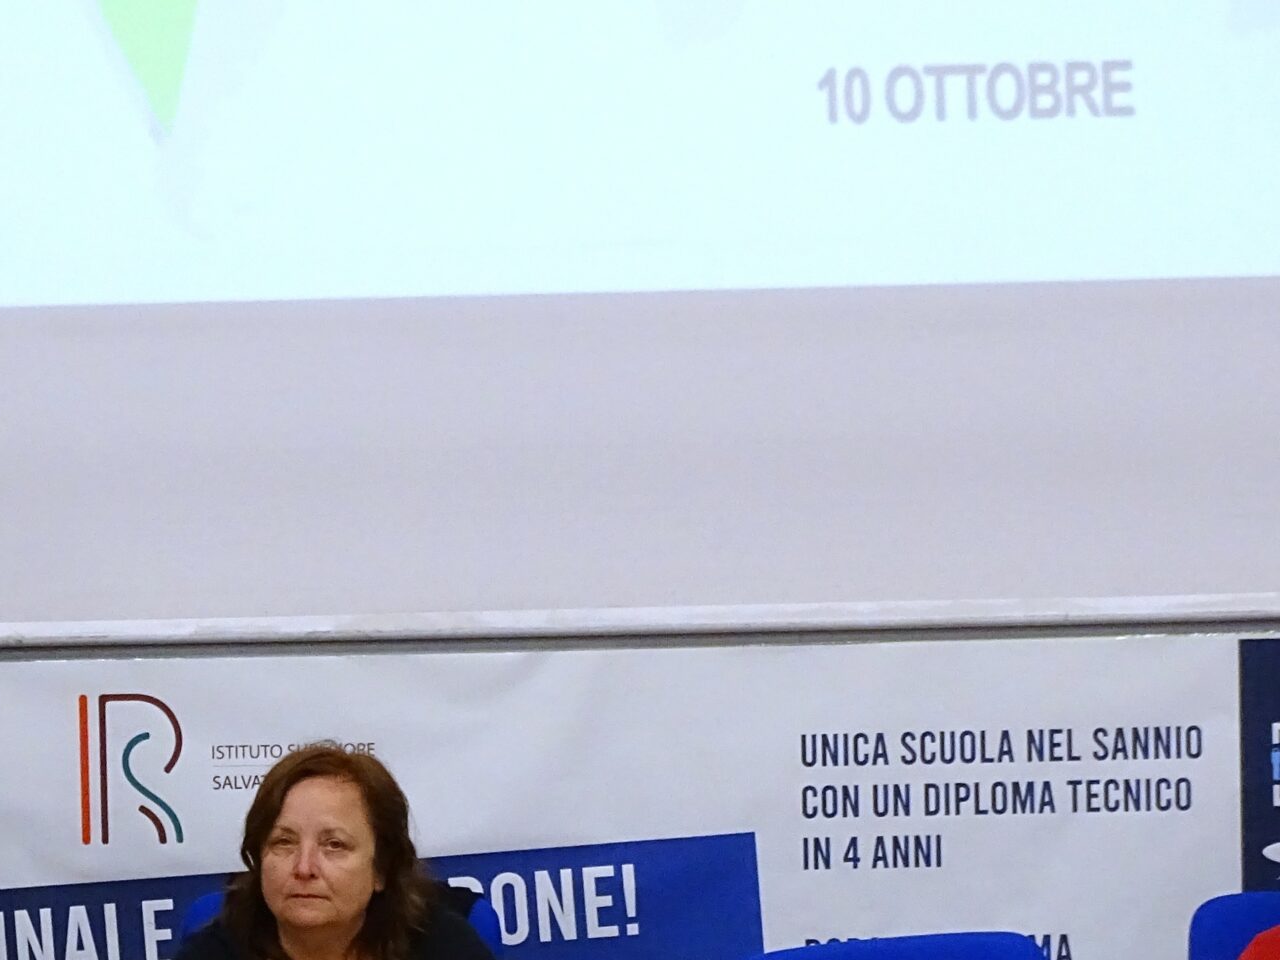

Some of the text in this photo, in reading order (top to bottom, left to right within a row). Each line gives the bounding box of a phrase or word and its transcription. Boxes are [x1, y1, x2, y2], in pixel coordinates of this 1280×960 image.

[818, 59, 1136, 125] 10 OTTOBRE
[211, 744, 283, 761] ISTITUTO
[800, 725, 1204, 768] UNICA SCUOLA NEL SANNIO
[212, 774, 267, 791] SALVA
[801, 777, 1193, 819] CON UN DIPLOMA TECNICO
[802, 834, 944, 871] IN 4 ANNI
